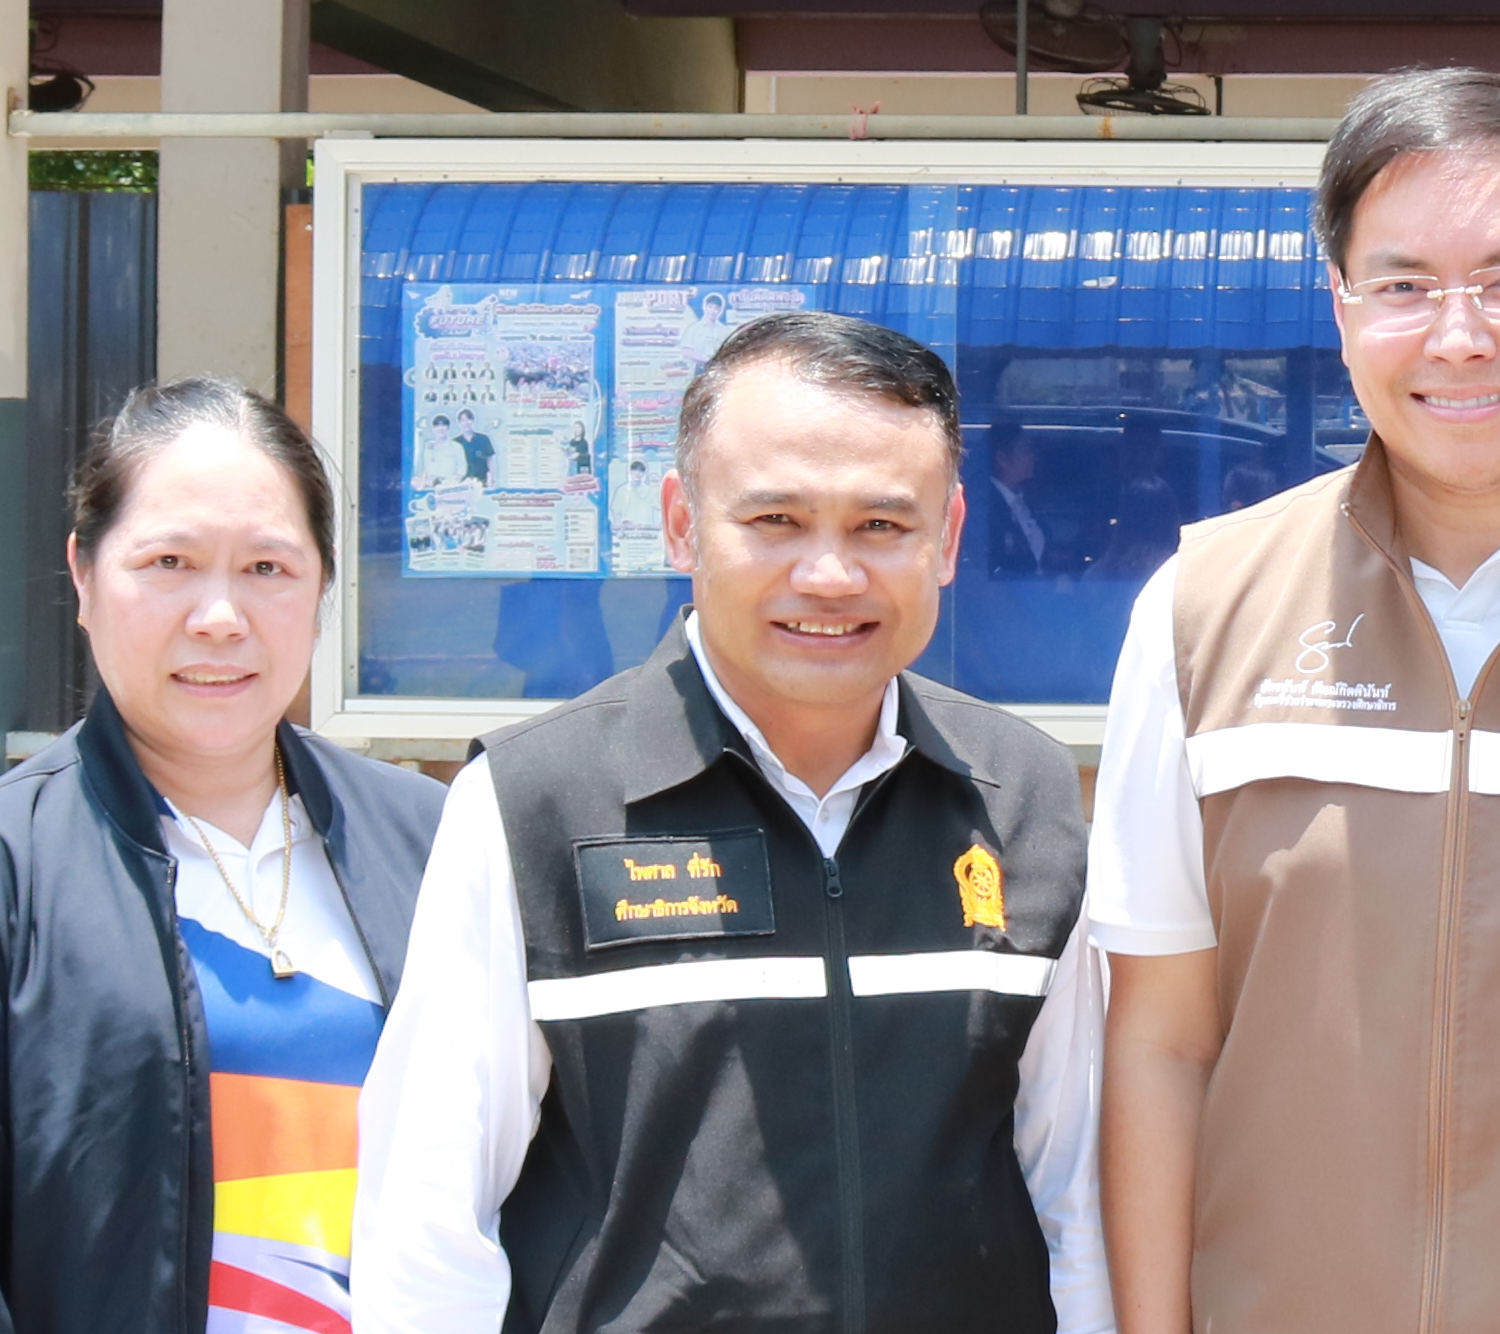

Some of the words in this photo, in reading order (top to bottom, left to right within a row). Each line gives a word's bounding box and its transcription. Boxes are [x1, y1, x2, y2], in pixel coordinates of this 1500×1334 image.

[430, 315, 486, 325] FUTURE
[624, 858, 676, 881] ไพศาล
[615, 895, 739, 921] ศึกษาธิการจังหวัด
